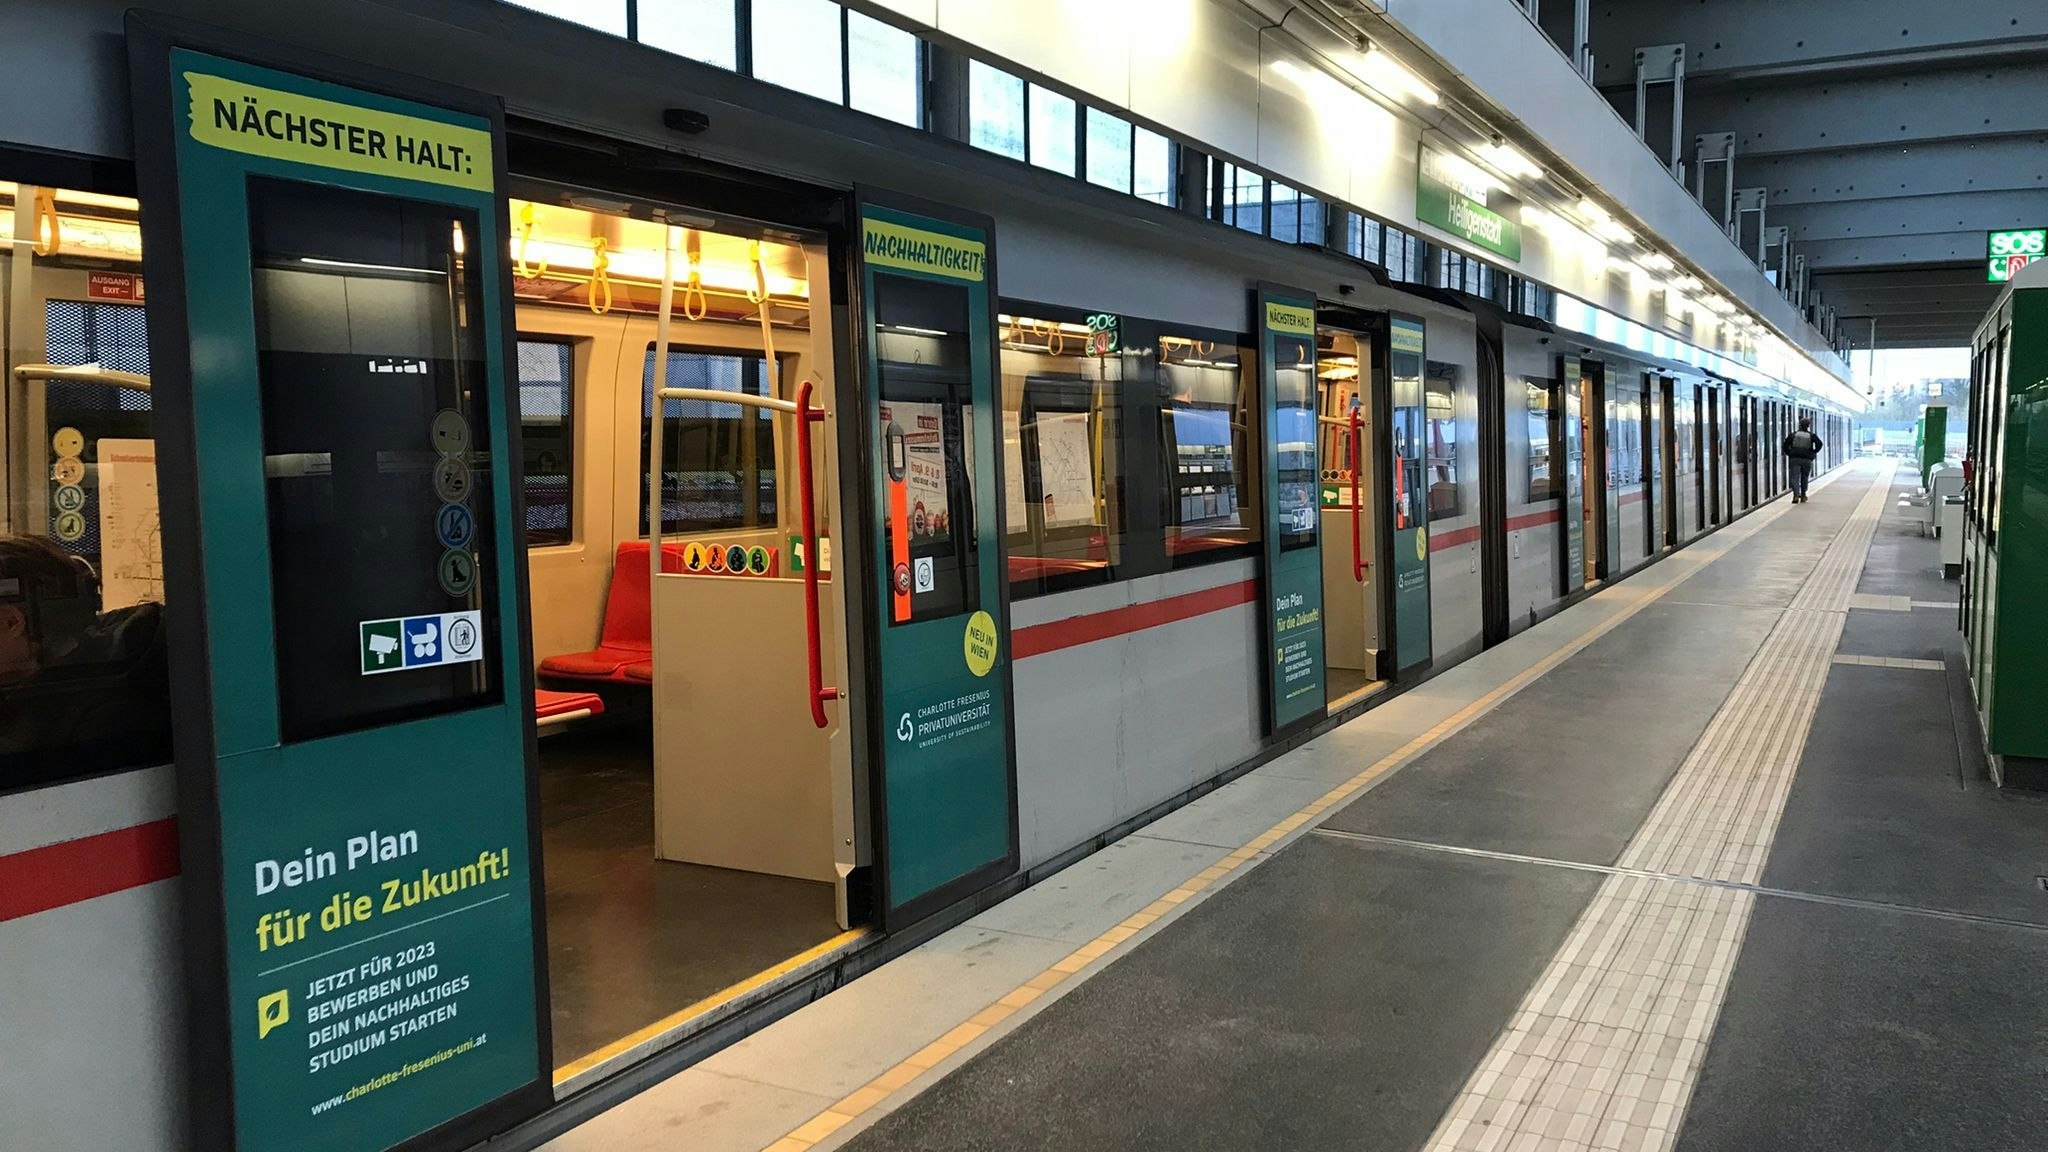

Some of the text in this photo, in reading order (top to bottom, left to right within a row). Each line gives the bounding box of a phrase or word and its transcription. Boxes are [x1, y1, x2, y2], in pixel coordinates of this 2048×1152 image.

[213, 96, 472, 175] NÄCHSTER HALT:
[1448, 192, 1502, 246] Heiligenstadt
[865, 231, 986, 274] NACHHALTIGKEIT!
[1991, 231, 2044, 255] SOS
[91, 276, 130, 286] AUSGANG
[102, 286, 120, 294] EXIT
[1269, 308, 1297, 326] NÄCHSTER
[1276, 592, 1303, 612] Dein Plan
[970, 626, 994, 647] NEU IN
[1286, 615, 1296, 630] die
[970, 642, 990, 661] WIEN
[917, 689, 991, 718] CHARLOTTE FRESENIUS
[918, 703, 991, 736] PRIVATUNIVERSITÄT
[919, 734, 947, 749] UNIVERSITY
[948, 731, 954, 739] OF
[255, 830, 418, 896] Dein Plan
[255, 847, 509, 952] für die Zukunft!
[305, 941, 436, 1000] JETZT FÜR 2023
[307, 964, 439, 1024] BEWERBEN UND
[308, 974, 470, 1049] DEIN NACHHALTIGES
[309, 1002, 458, 1074] STUDIUM STARTEN
[311, 1032, 487, 1116] www.charlotte-fresenius-uni.at
